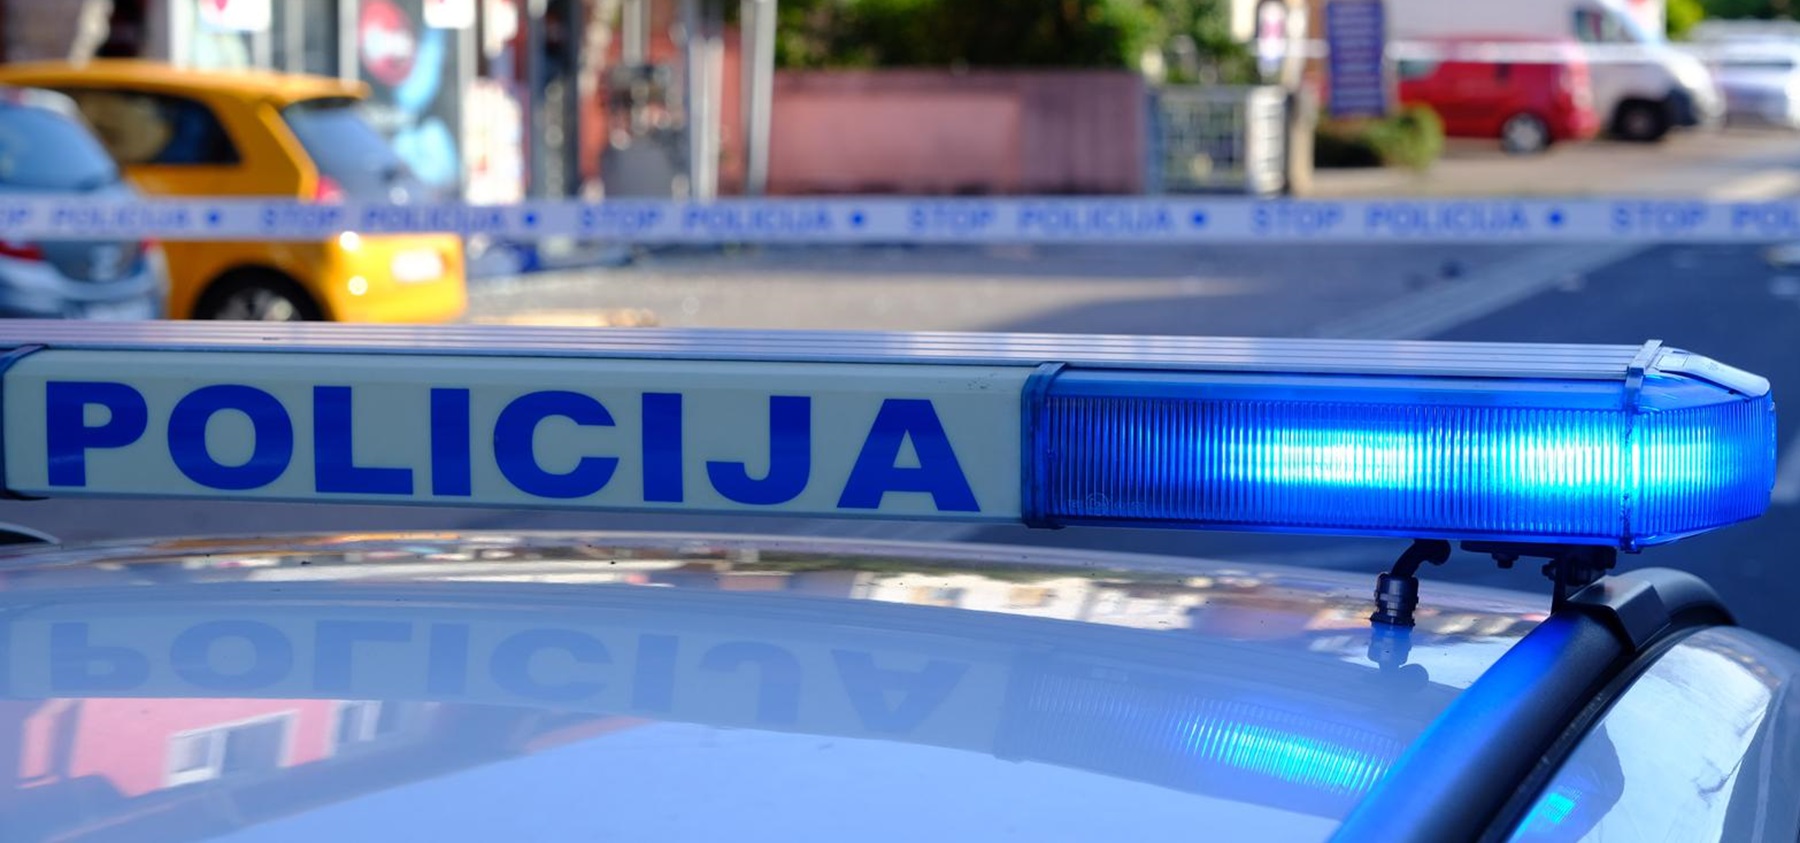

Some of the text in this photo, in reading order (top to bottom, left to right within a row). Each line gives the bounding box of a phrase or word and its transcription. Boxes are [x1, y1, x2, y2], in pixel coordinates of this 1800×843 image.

[260, 204, 342, 234] STOP
[579, 204, 664, 234] STOP
[681, 204, 832, 235] POLICIJA
[908, 203, 996, 235] STOP
[1018, 203, 1173, 235] POLICIJA
[1251, 203, 1344, 236] STOP
[1365, 203, 1529, 236] POLICIJA
[1610, 203, 1707, 236] STOP
[46, 381, 980, 512] POLICIJA
